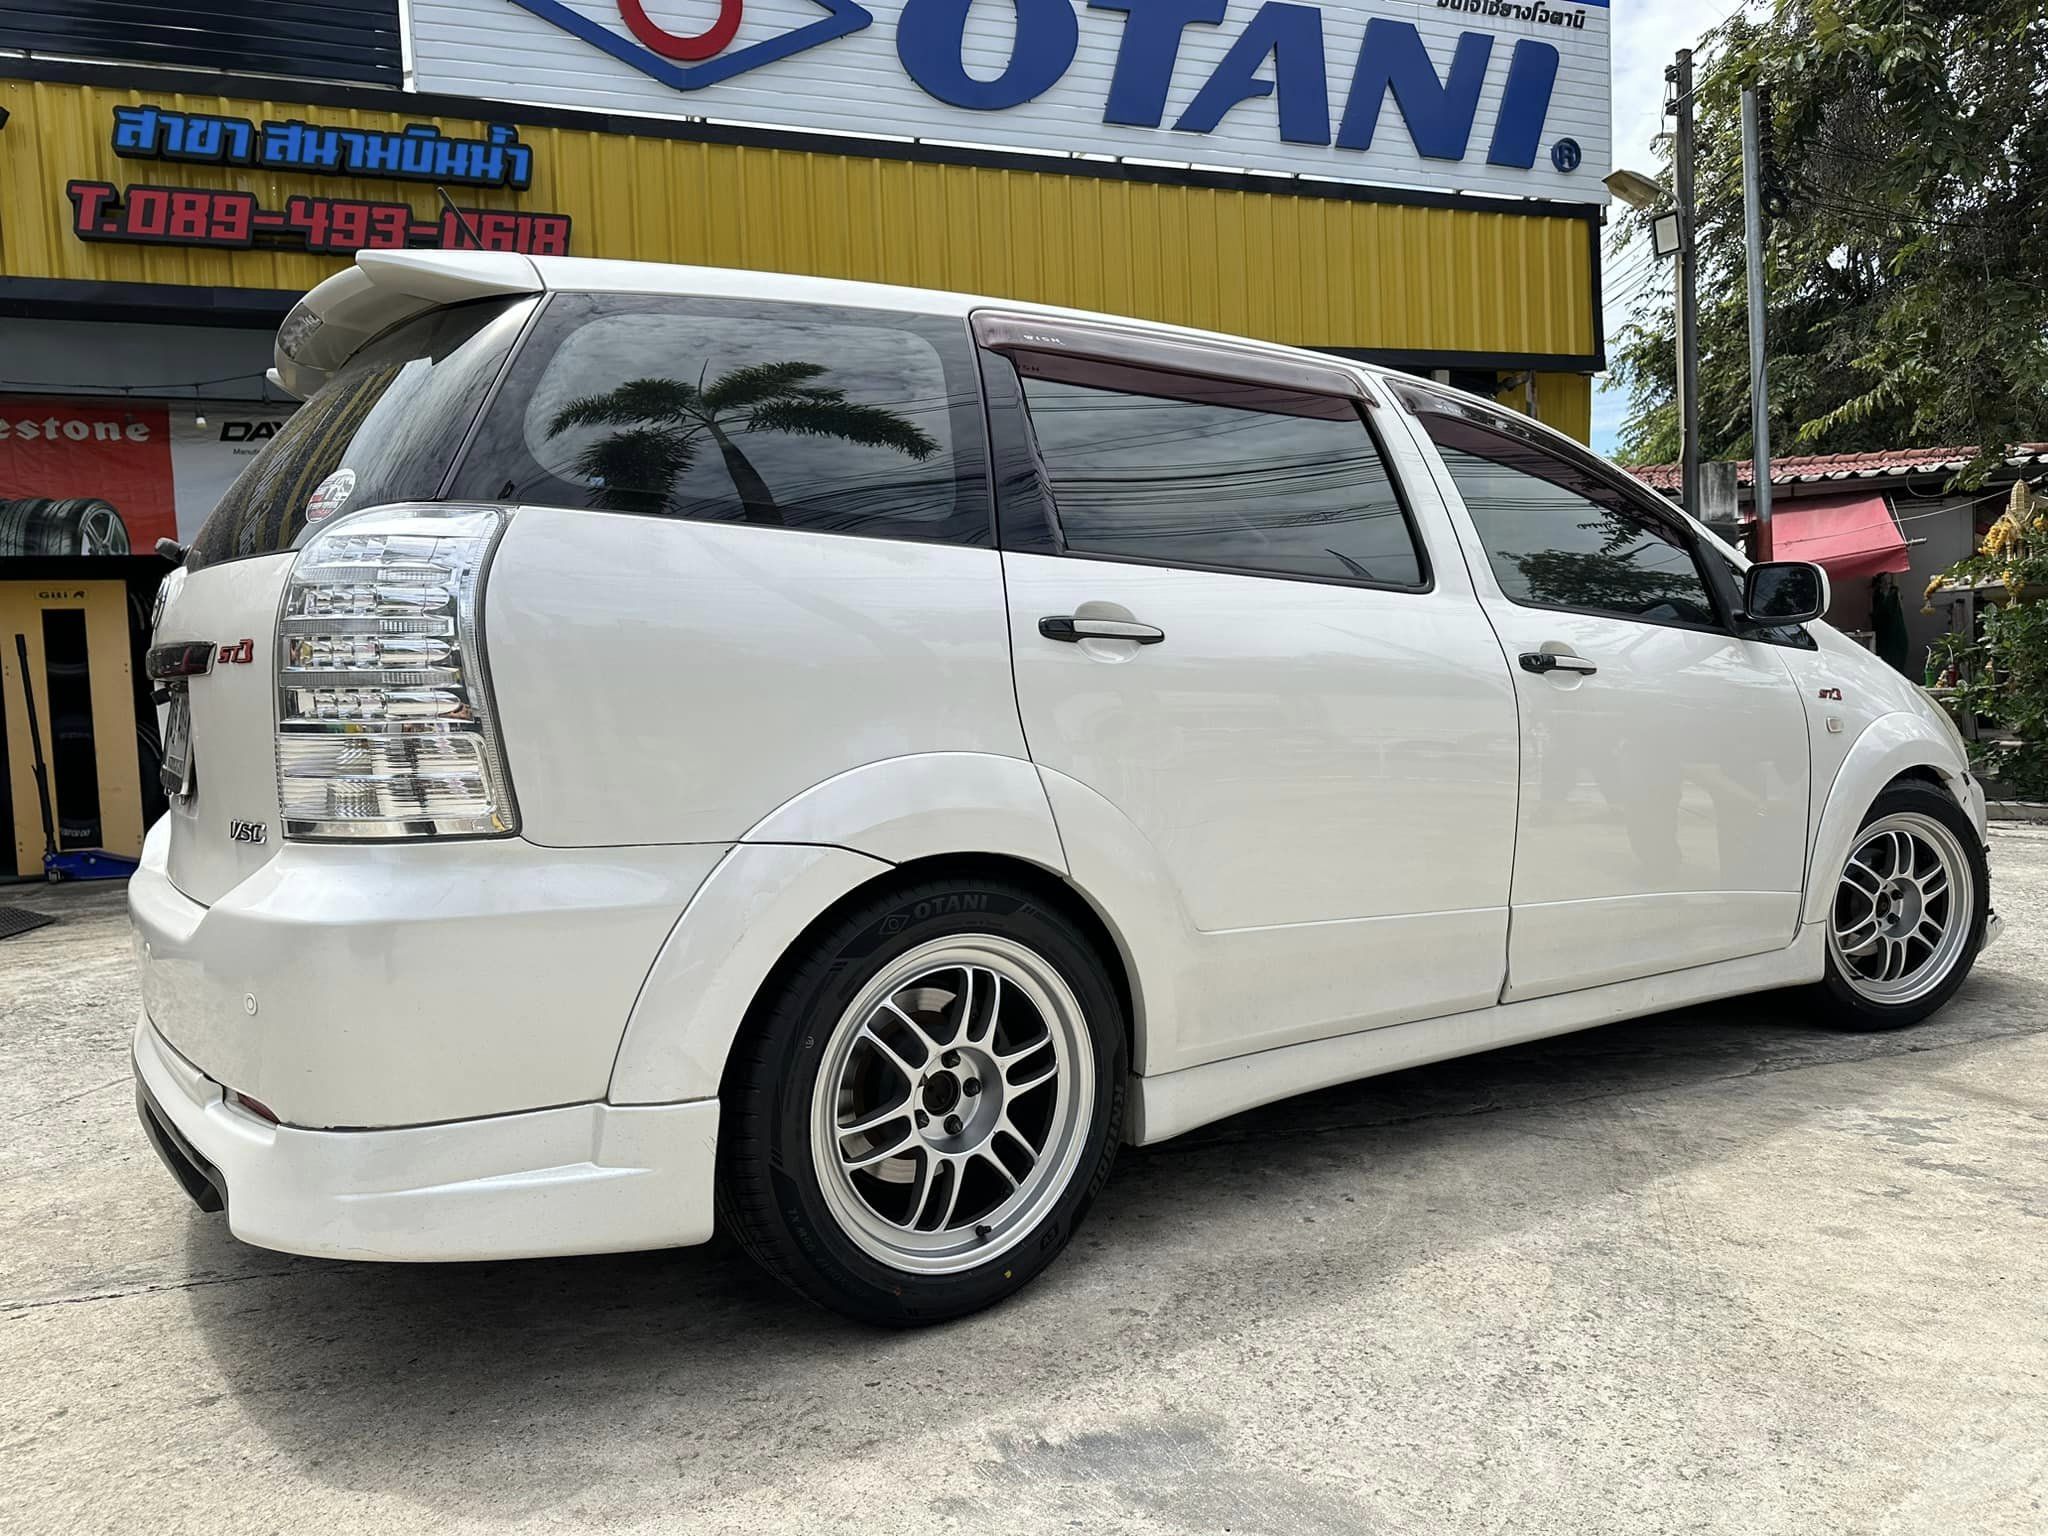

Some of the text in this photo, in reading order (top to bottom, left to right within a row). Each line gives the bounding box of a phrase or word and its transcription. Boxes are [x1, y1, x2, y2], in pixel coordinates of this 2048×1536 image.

[896, 0, 1559, 169] OTANI
[116, 110, 530, 182] สาขา สนามบินน้ำ
[230, 819, 266, 844] VSC
[913, 893, 988, 919] OTANI
